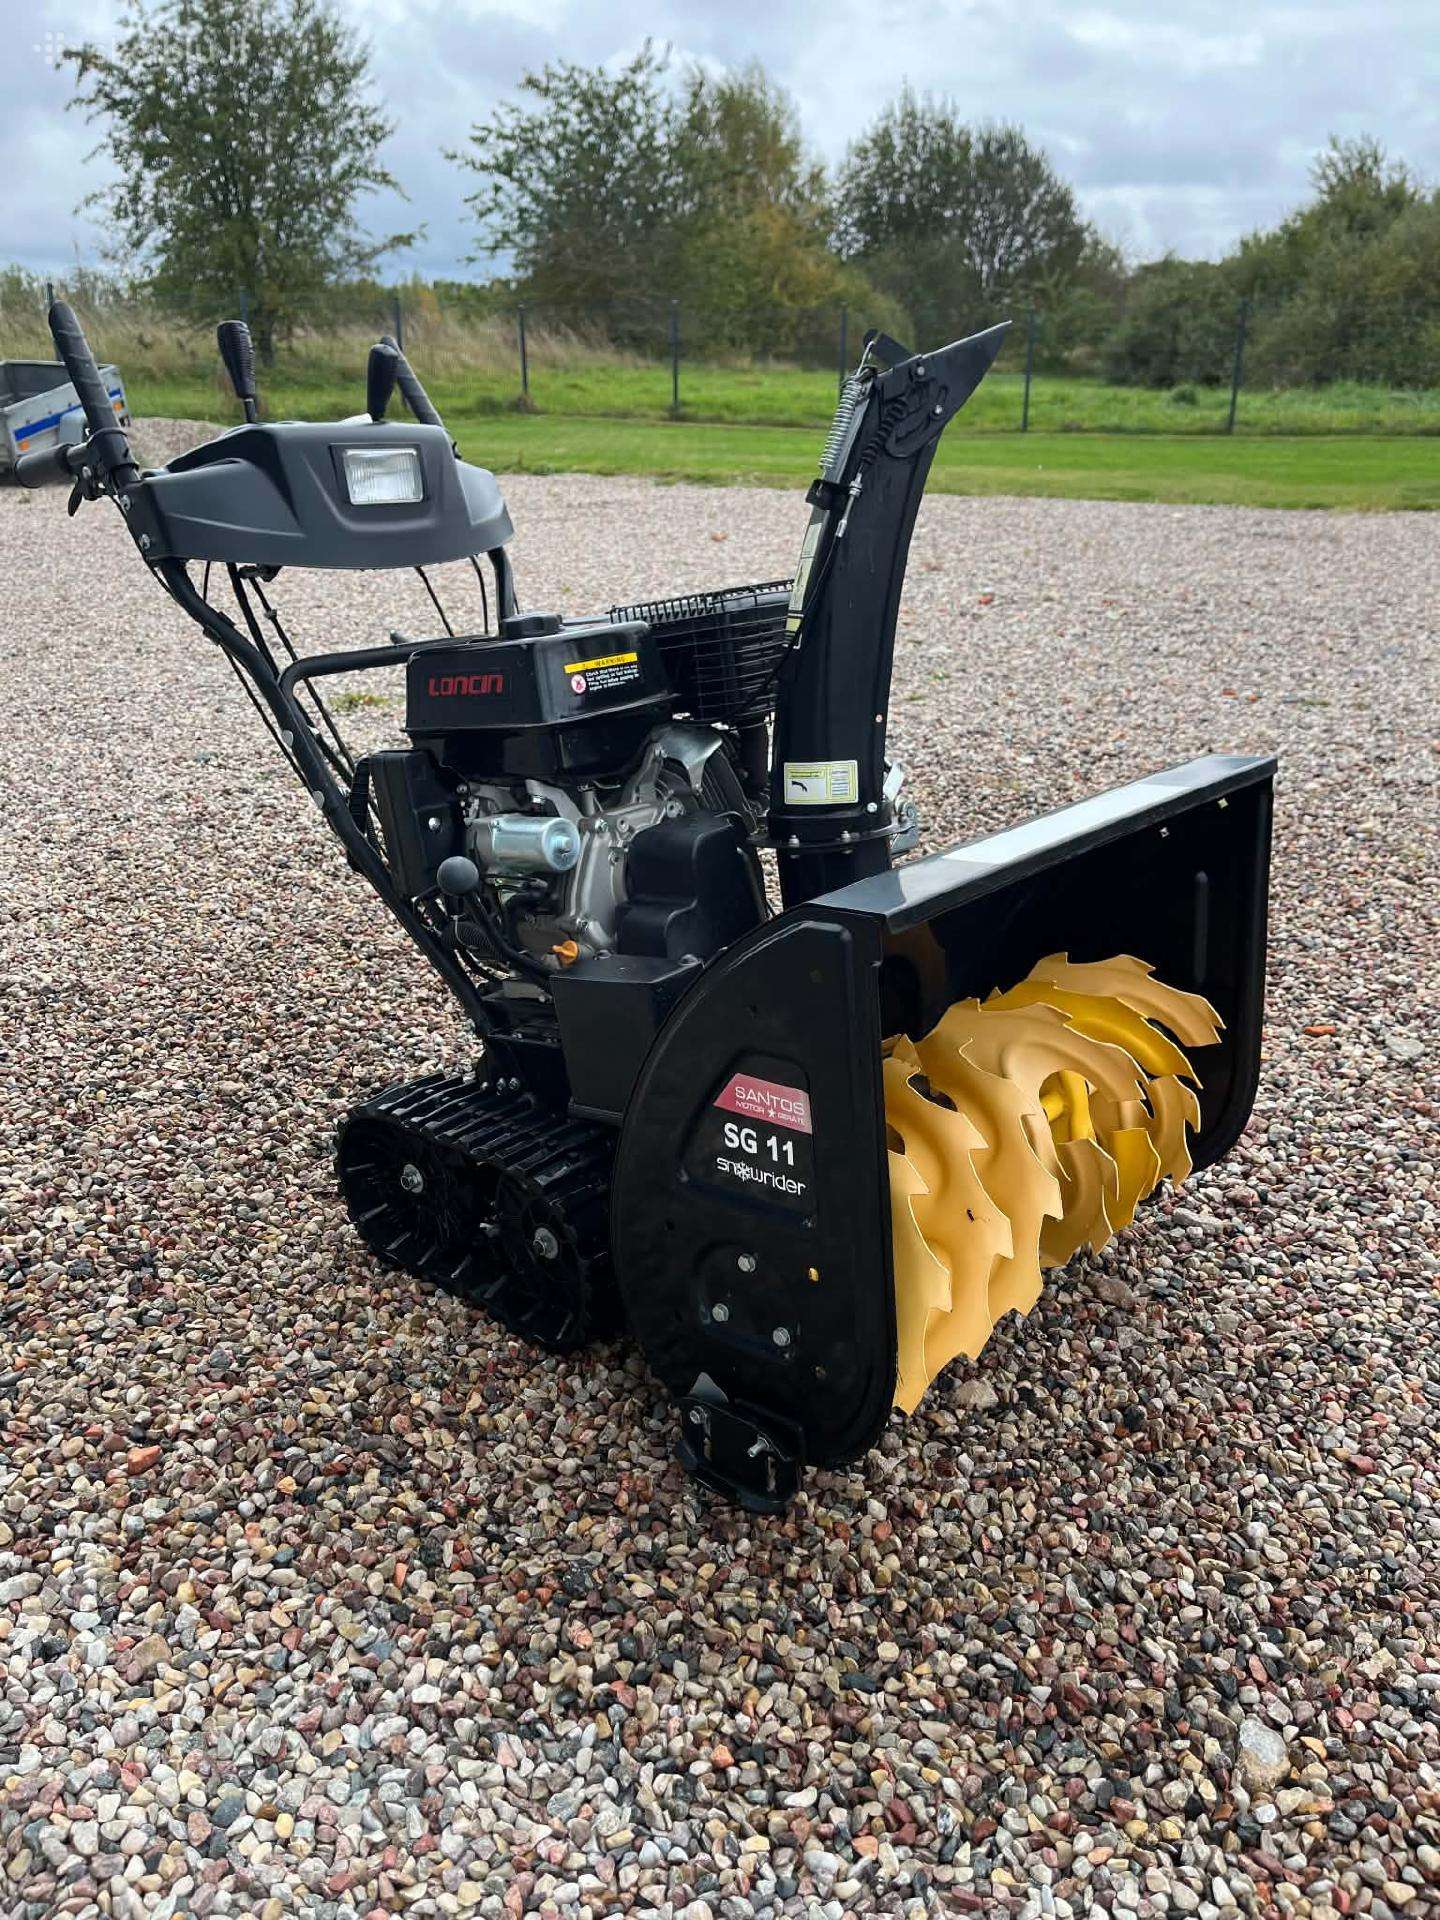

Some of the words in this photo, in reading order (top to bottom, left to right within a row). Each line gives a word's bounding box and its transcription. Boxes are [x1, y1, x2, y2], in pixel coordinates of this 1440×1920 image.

[735, 1086, 805, 1116] SANTOS
[735, 1100, 765, 1114] MOTOR
[724, 1122, 758, 1154] SG
[767, 1135, 795, 1167] 11
